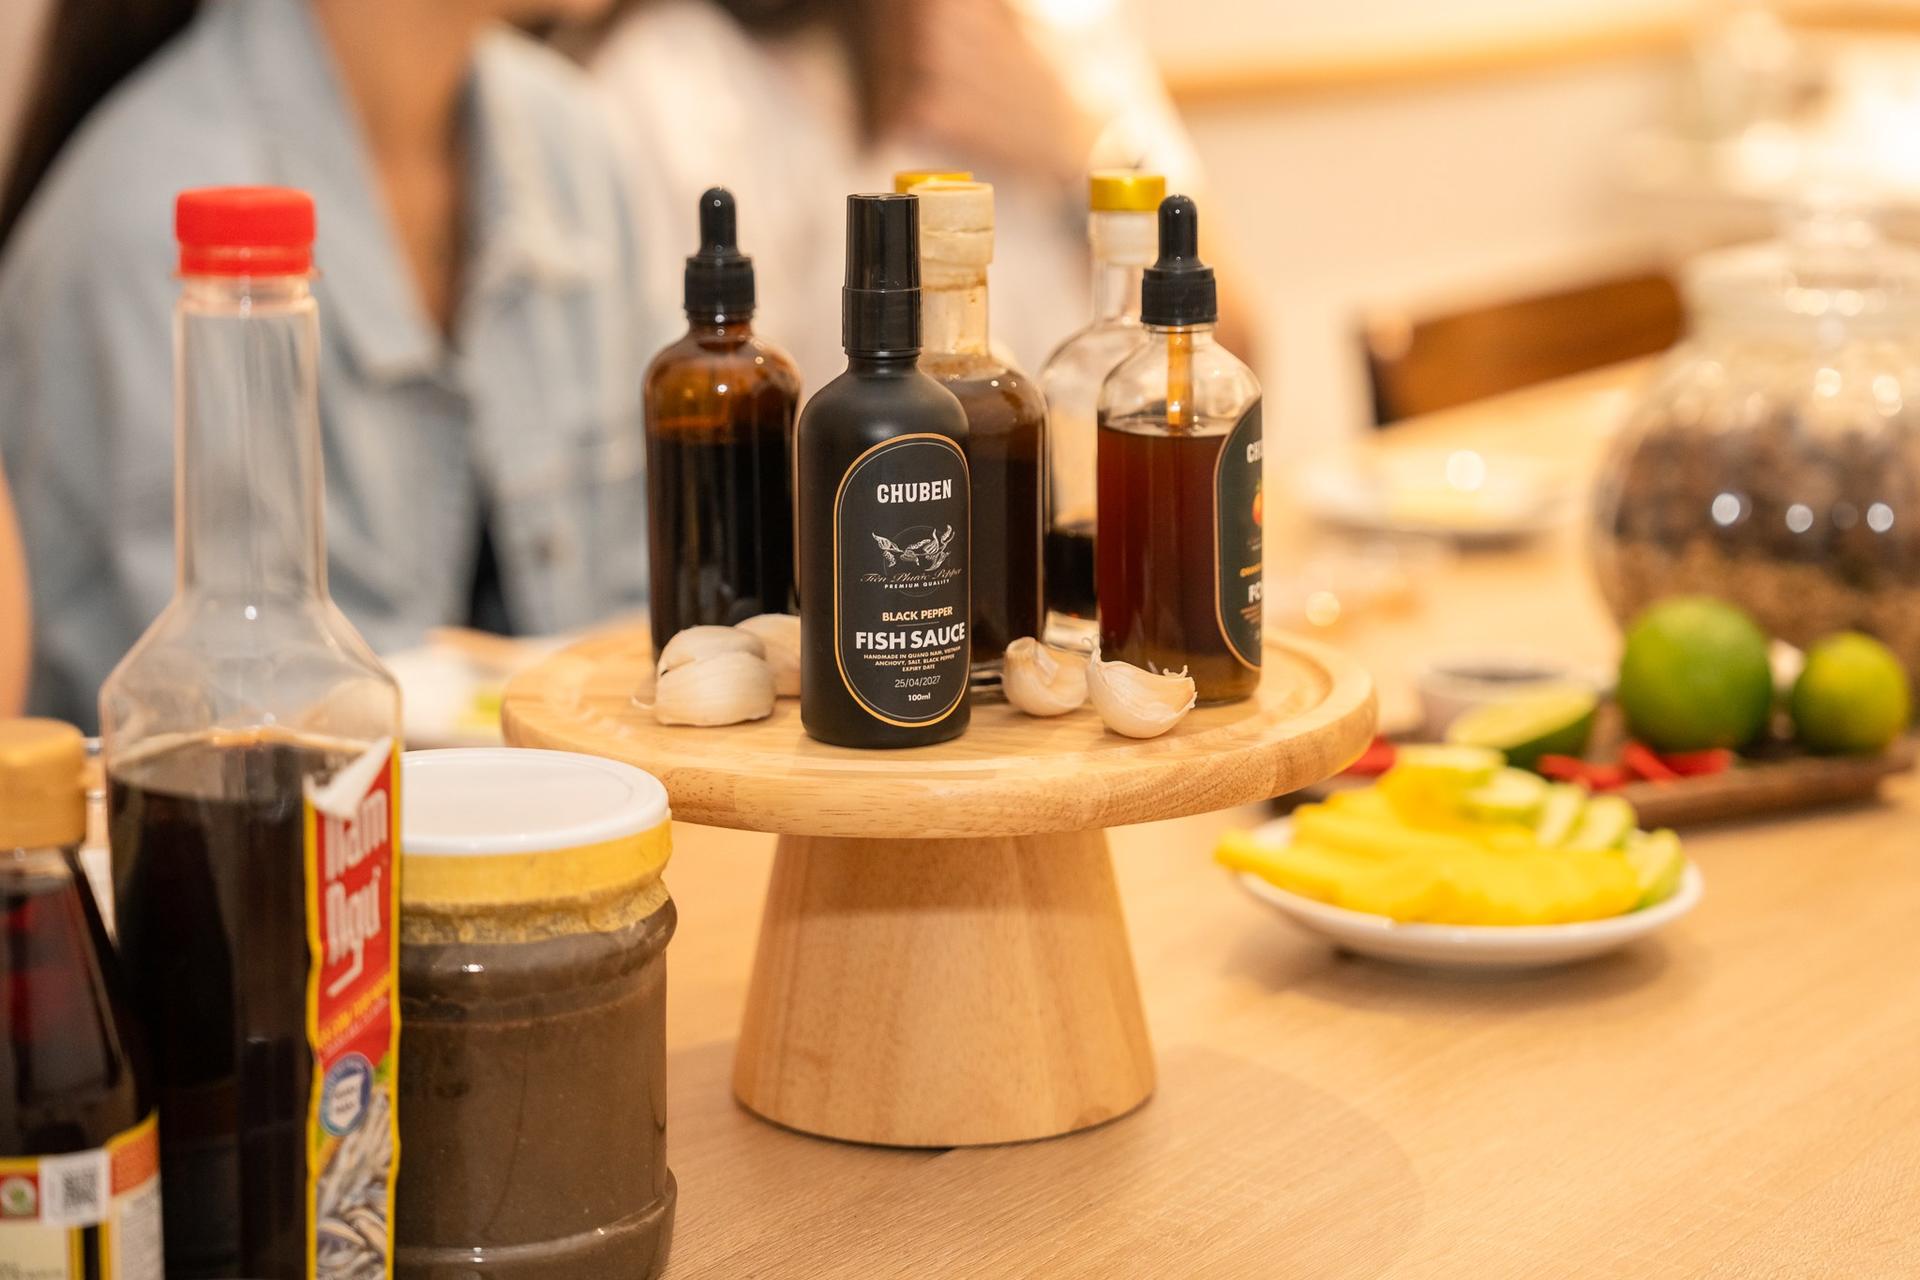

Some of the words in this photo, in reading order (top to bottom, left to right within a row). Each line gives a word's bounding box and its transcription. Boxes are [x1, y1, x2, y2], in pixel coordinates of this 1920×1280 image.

[876, 479, 953, 504] CHUBEN
[884, 582, 920, 590] PREMIUM
[922, 578, 951, 588] QUALITY
[881, 611, 919, 622] BLACK
[920, 606, 954, 620] PEPPER
[855, 631, 907, 651] FISH
[910, 621, 967, 650] SAUCE
[922, 656, 939, 664] BLACK
[939, 653, 956, 662] PEPPER
[901, 665, 922, 673] EXPIRY
[922, 663, 936, 671] DATE
[894, 675, 942, 689] 25/04/2027
[907, 692, 932, 702] 100ml
